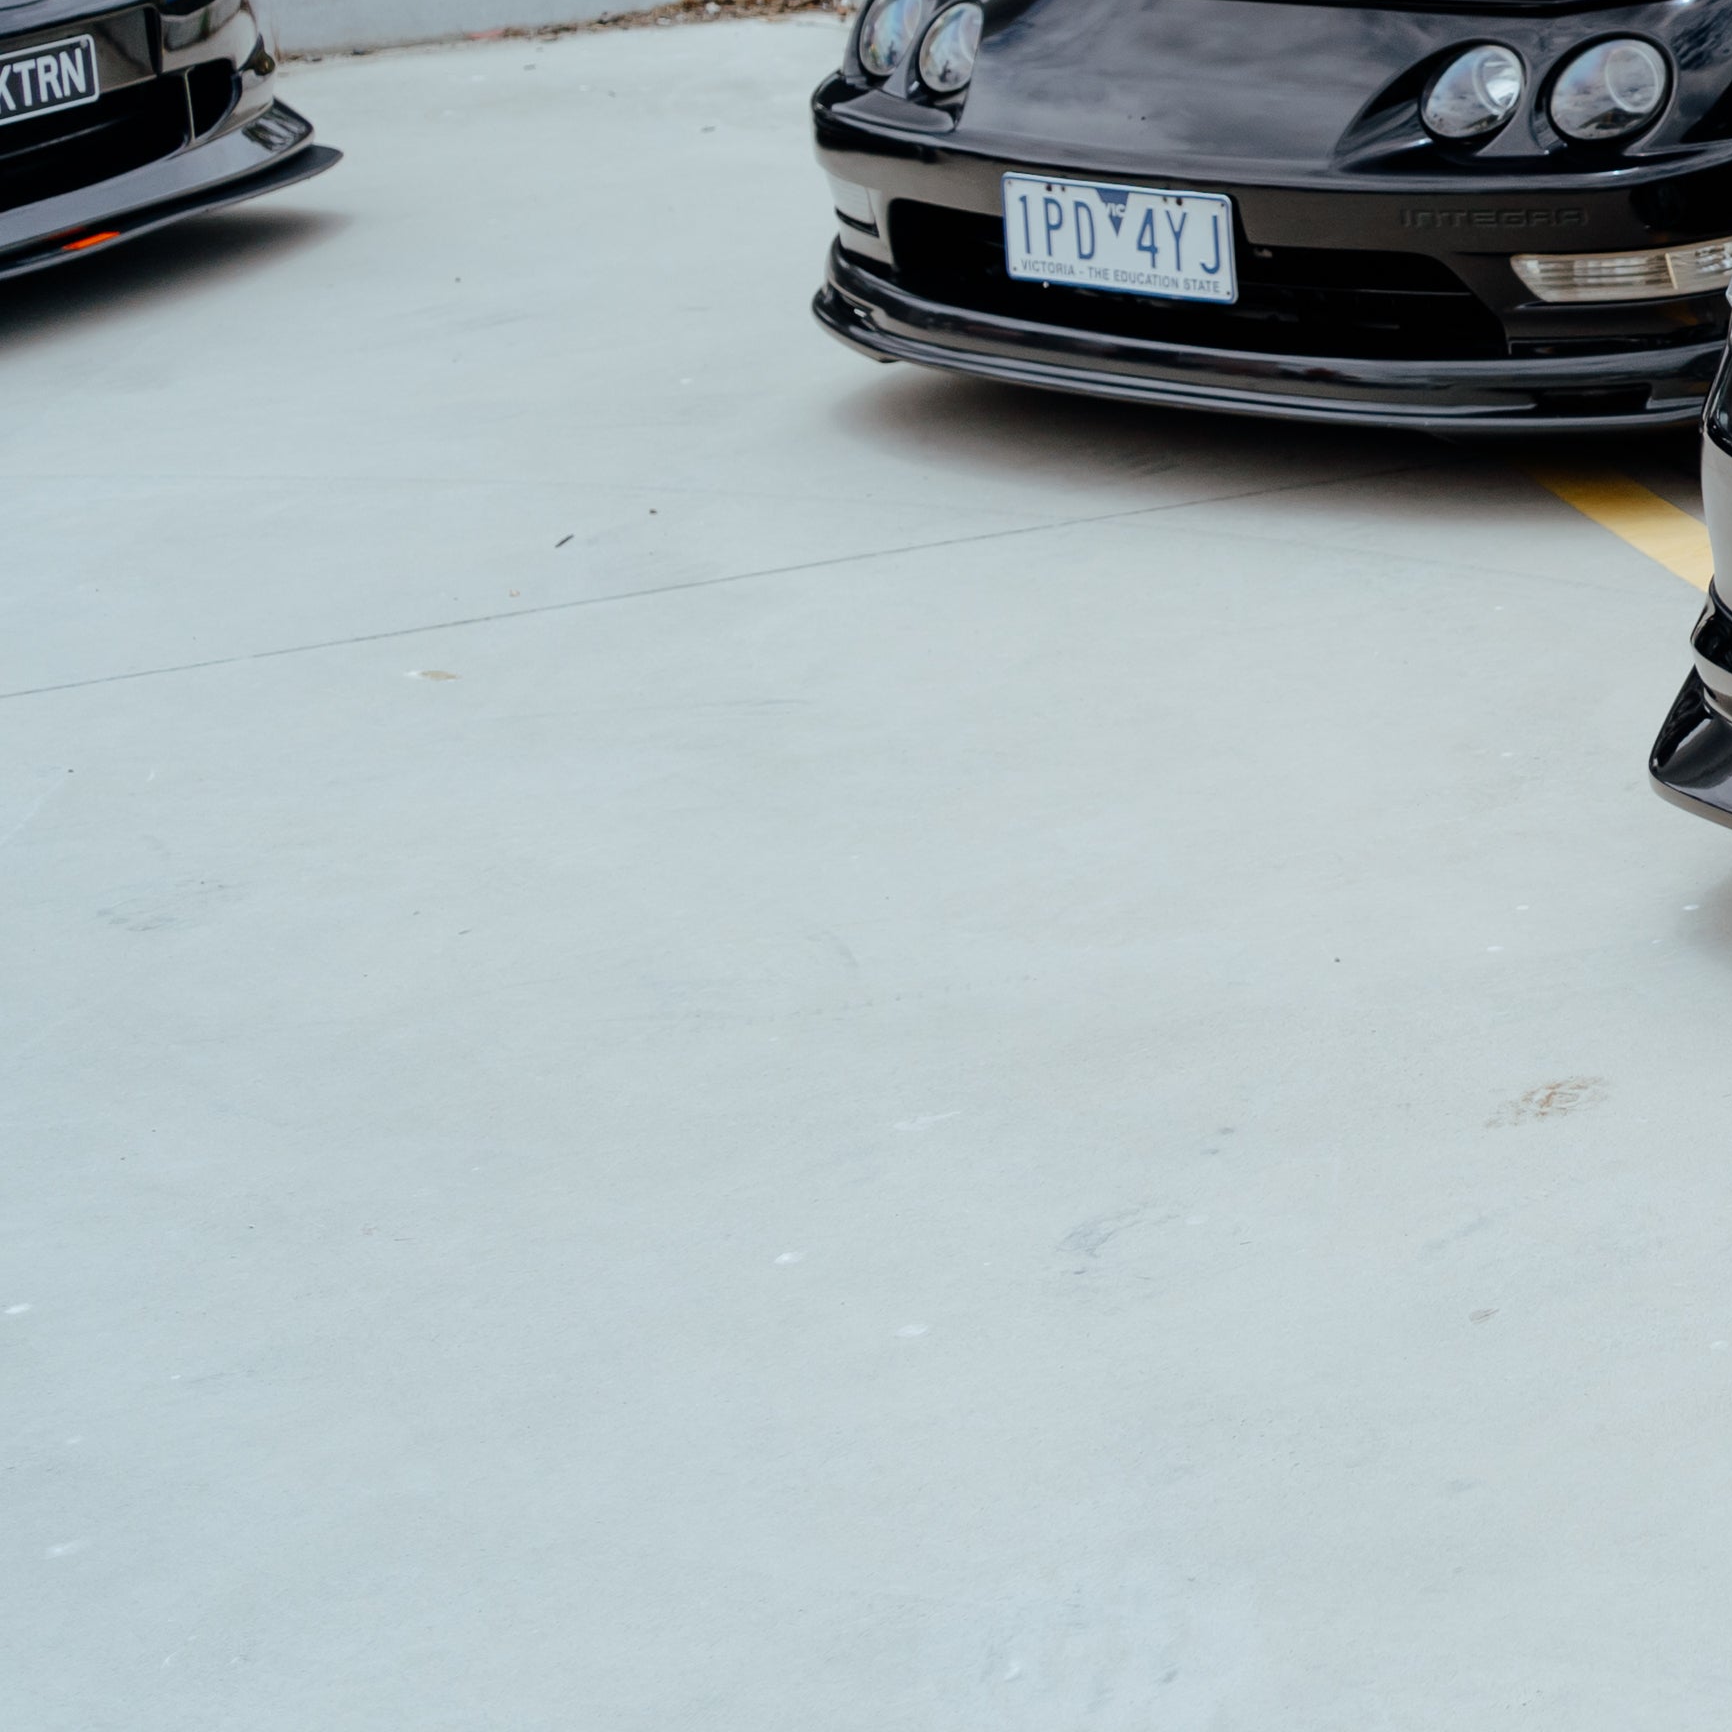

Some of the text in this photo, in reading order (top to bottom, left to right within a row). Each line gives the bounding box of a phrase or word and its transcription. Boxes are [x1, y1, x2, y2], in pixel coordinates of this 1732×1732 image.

[1400, 209, 1590, 229] INTEGRA
[1020, 259, 1076, 278] VICTORIA
[1087, 266, 1110, 282] THE
[1113, 269, 1179, 290] EDUCATION
[1184, 277, 1221, 294] STATE
